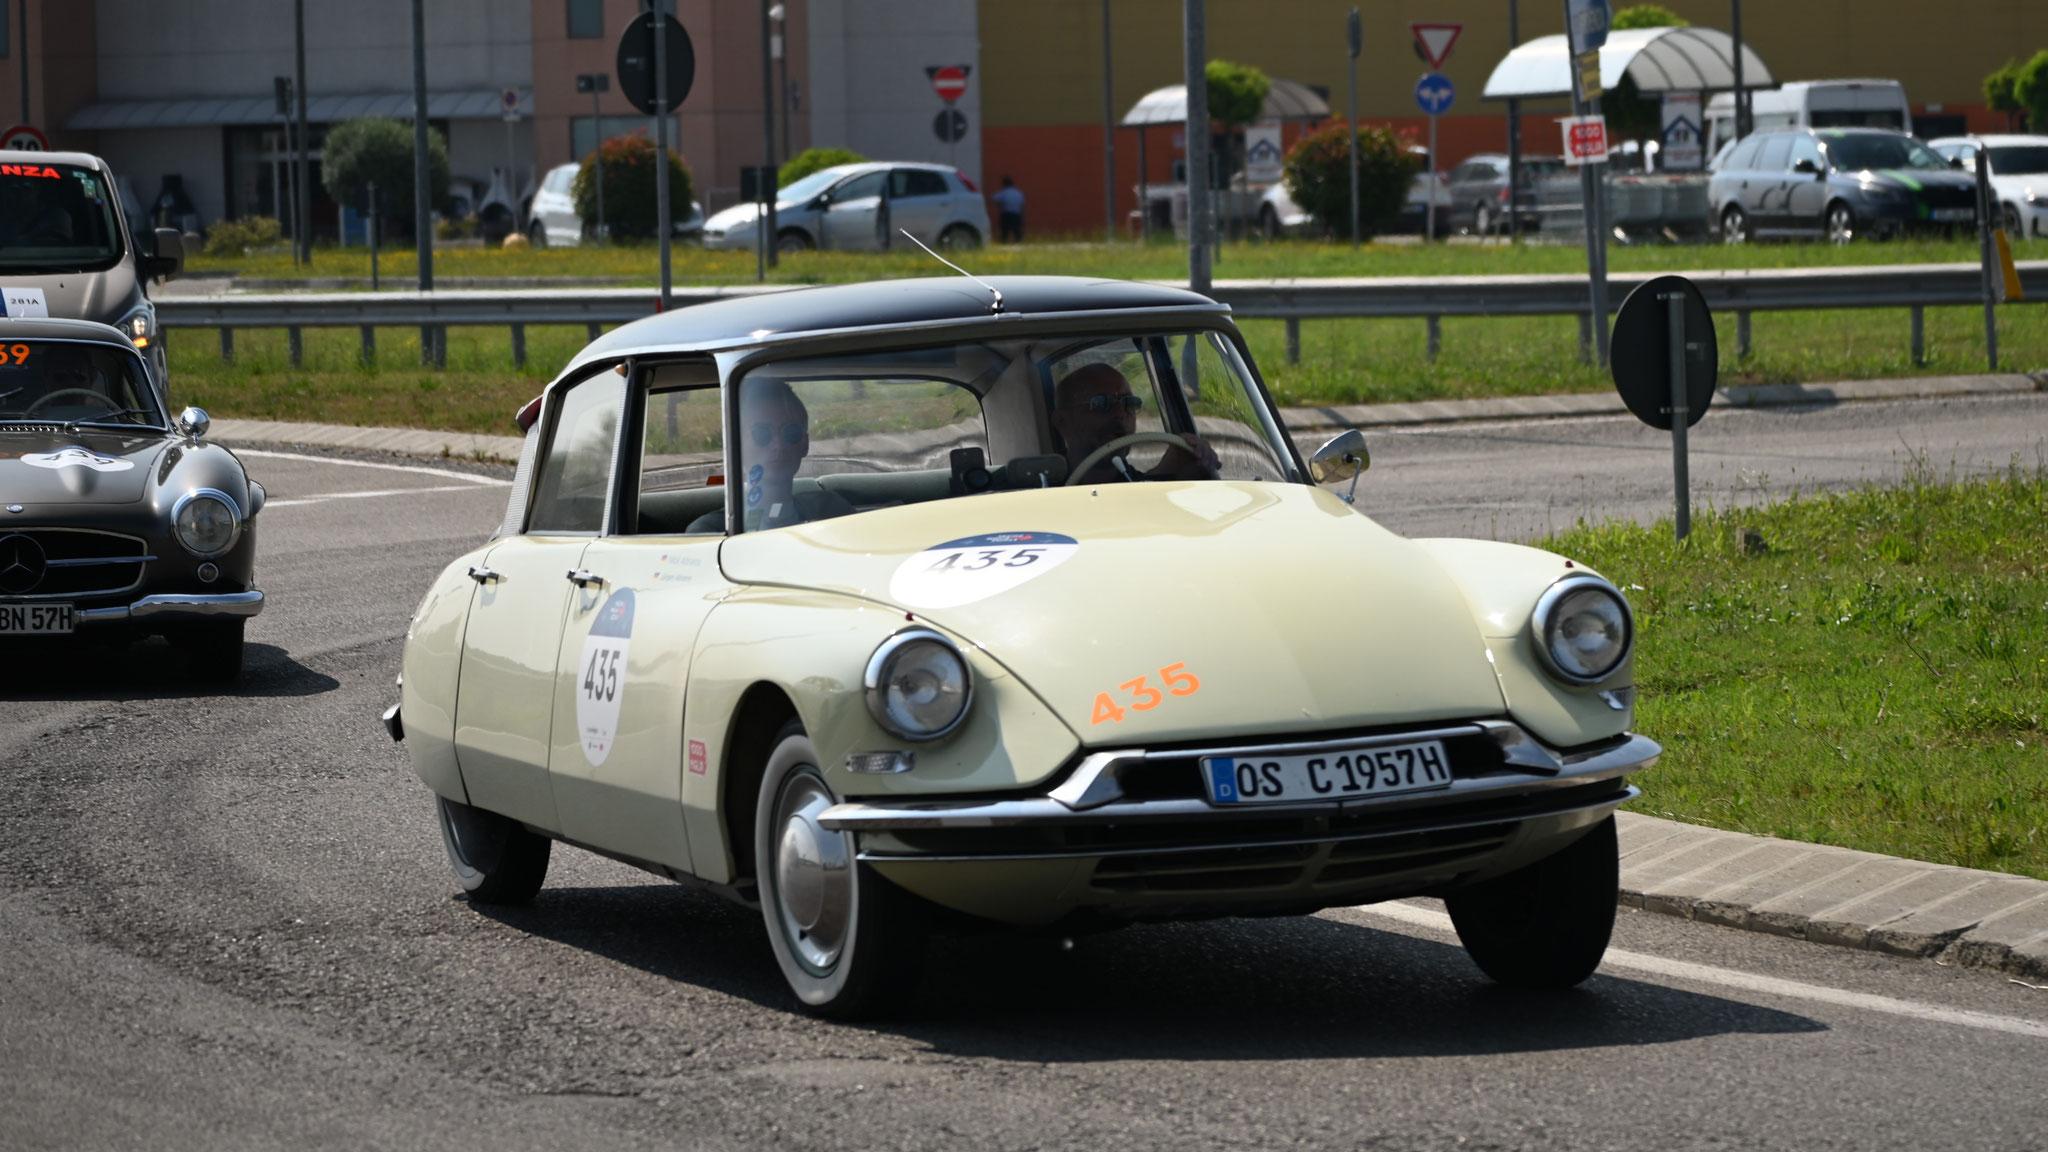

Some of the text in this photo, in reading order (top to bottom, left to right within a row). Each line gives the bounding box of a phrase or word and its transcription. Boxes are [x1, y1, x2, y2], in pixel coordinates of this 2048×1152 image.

[0, 164, 61, 179] NZA
[923, 548, 1048, 575] 435
[32, 606, 72, 630] 57H
[584, 648, 620, 702] 435
[1090, 661, 1200, 726] 435
[1219, 783, 1232, 797] D
[1236, 762, 1283, 797] OS
